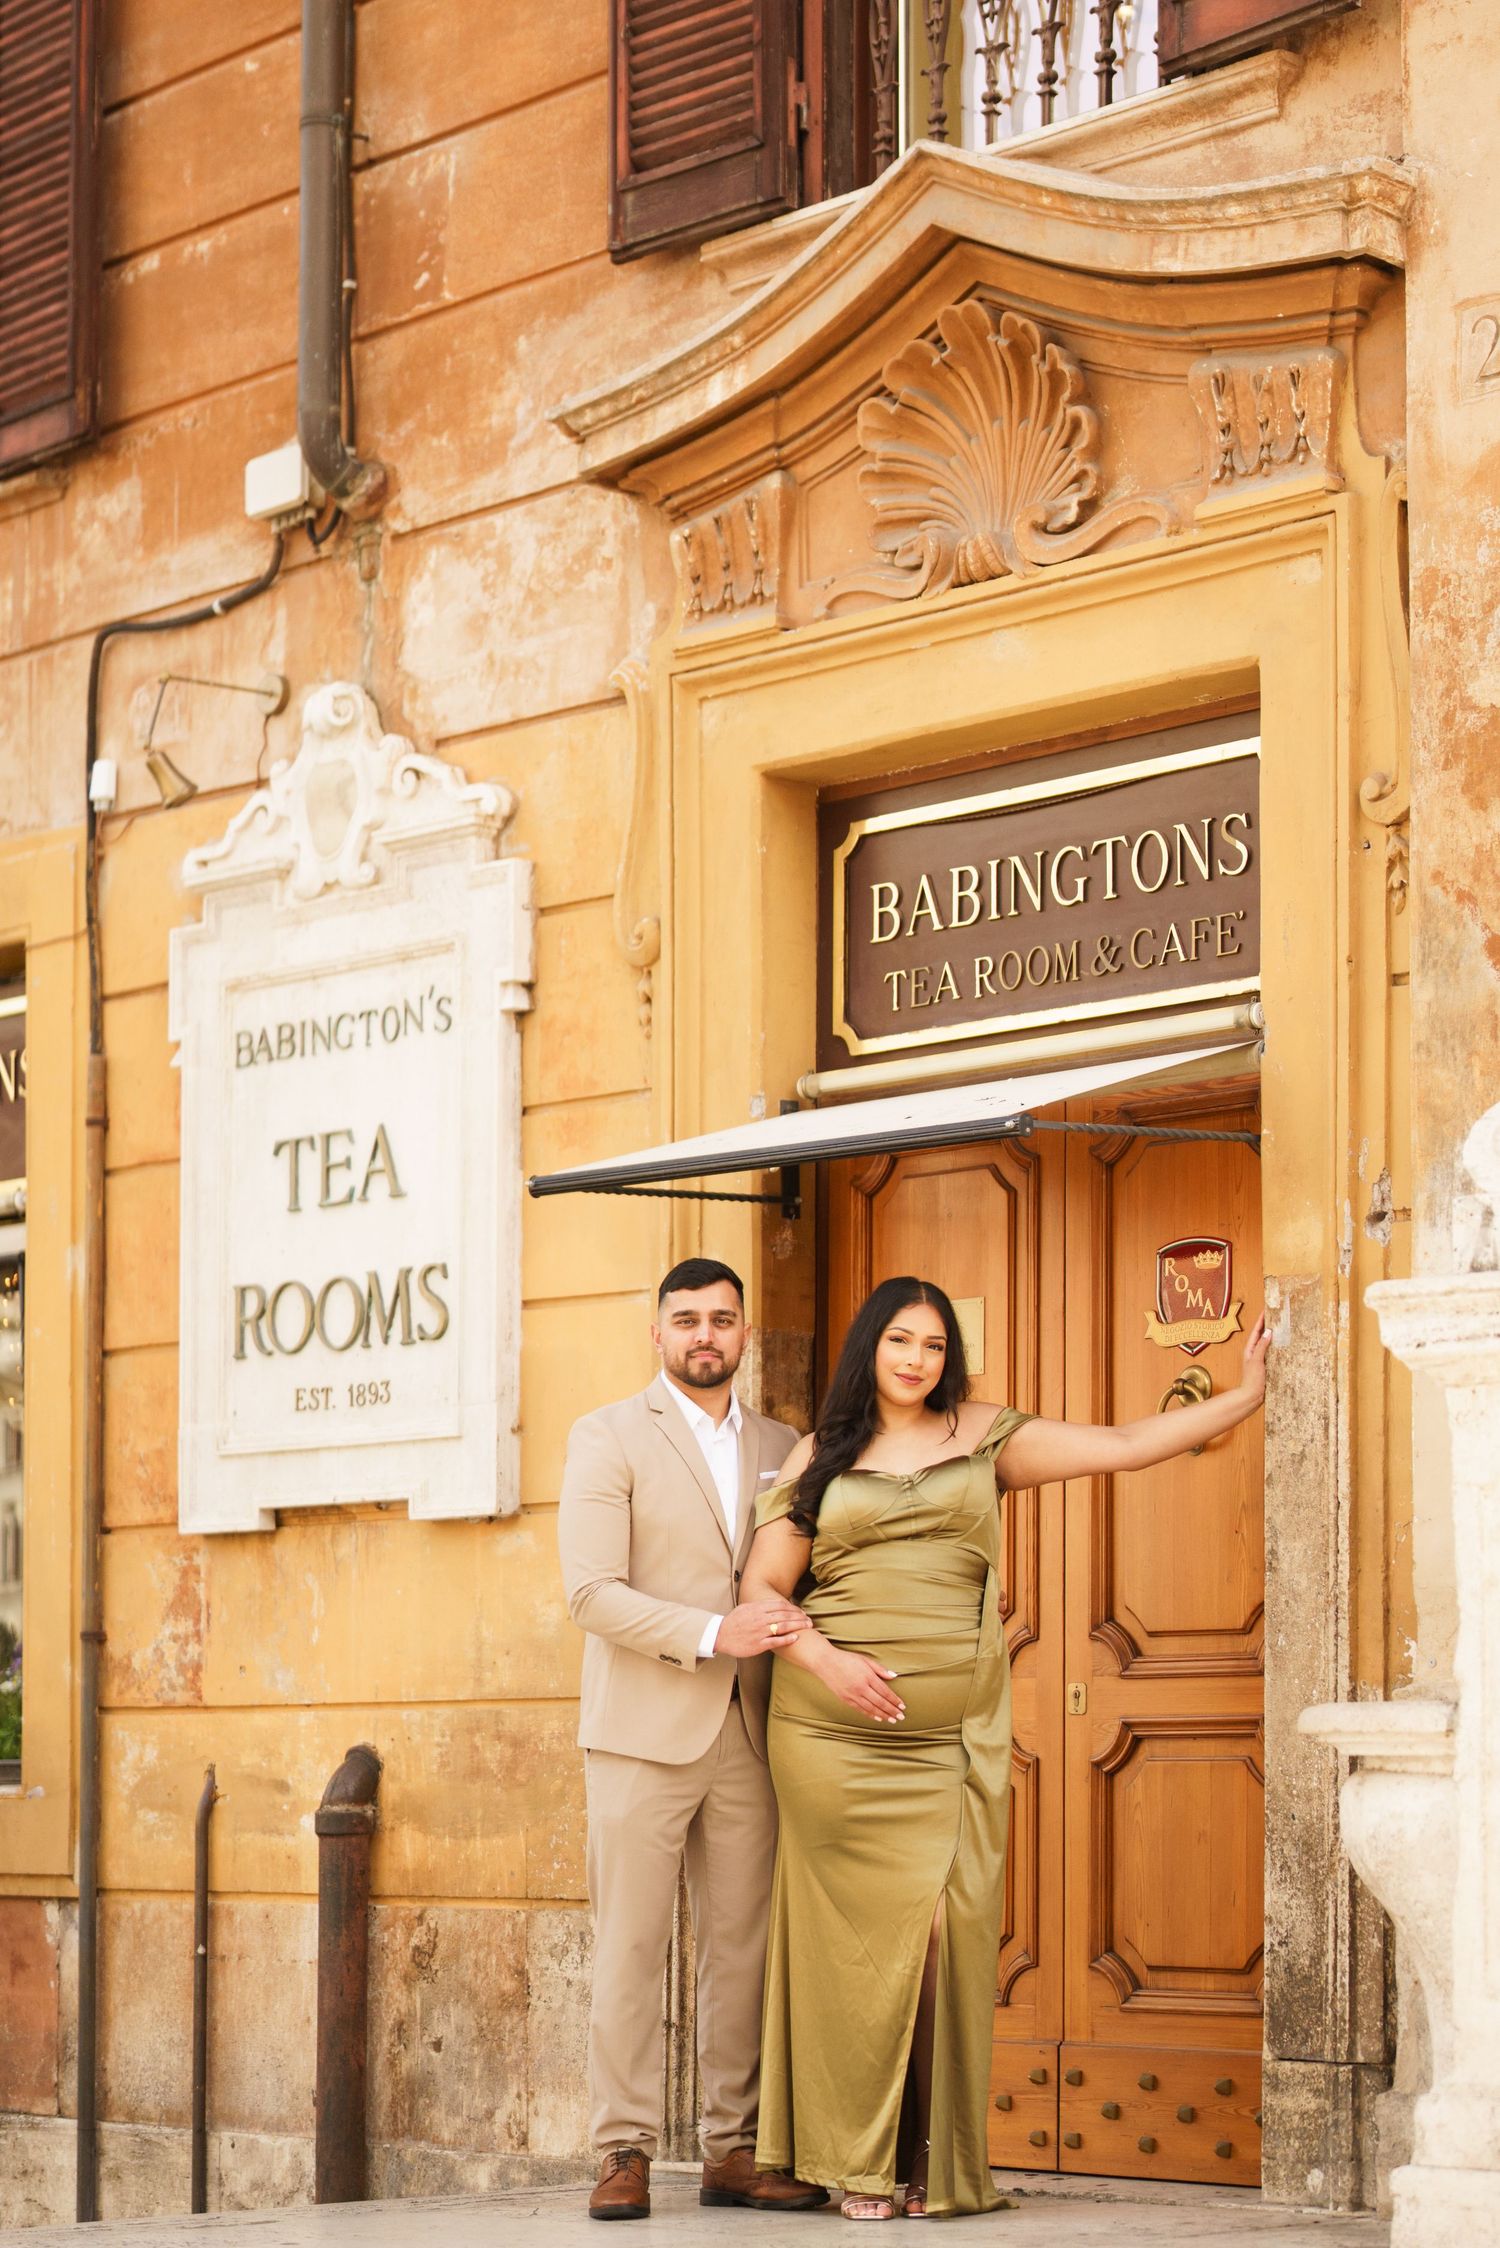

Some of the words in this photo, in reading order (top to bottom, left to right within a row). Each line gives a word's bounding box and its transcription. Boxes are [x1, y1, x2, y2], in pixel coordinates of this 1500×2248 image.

[870, 812, 1250, 945] BABINGTONS
[883, 961, 961, 1012] TEA
[974, 939, 1082, 998] ROOM
[1090, 934, 1124, 977] &
[235, 984, 454, 1069] BABINGTON'S
[273, 1123, 407, 1212] TEA
[233, 1262, 450, 1360] ROOMS
[1164, 1257, 1216, 1318] ROMA
[295, 1387, 336, 1411] EST.
[347, 1379, 392, 1408] 1893
